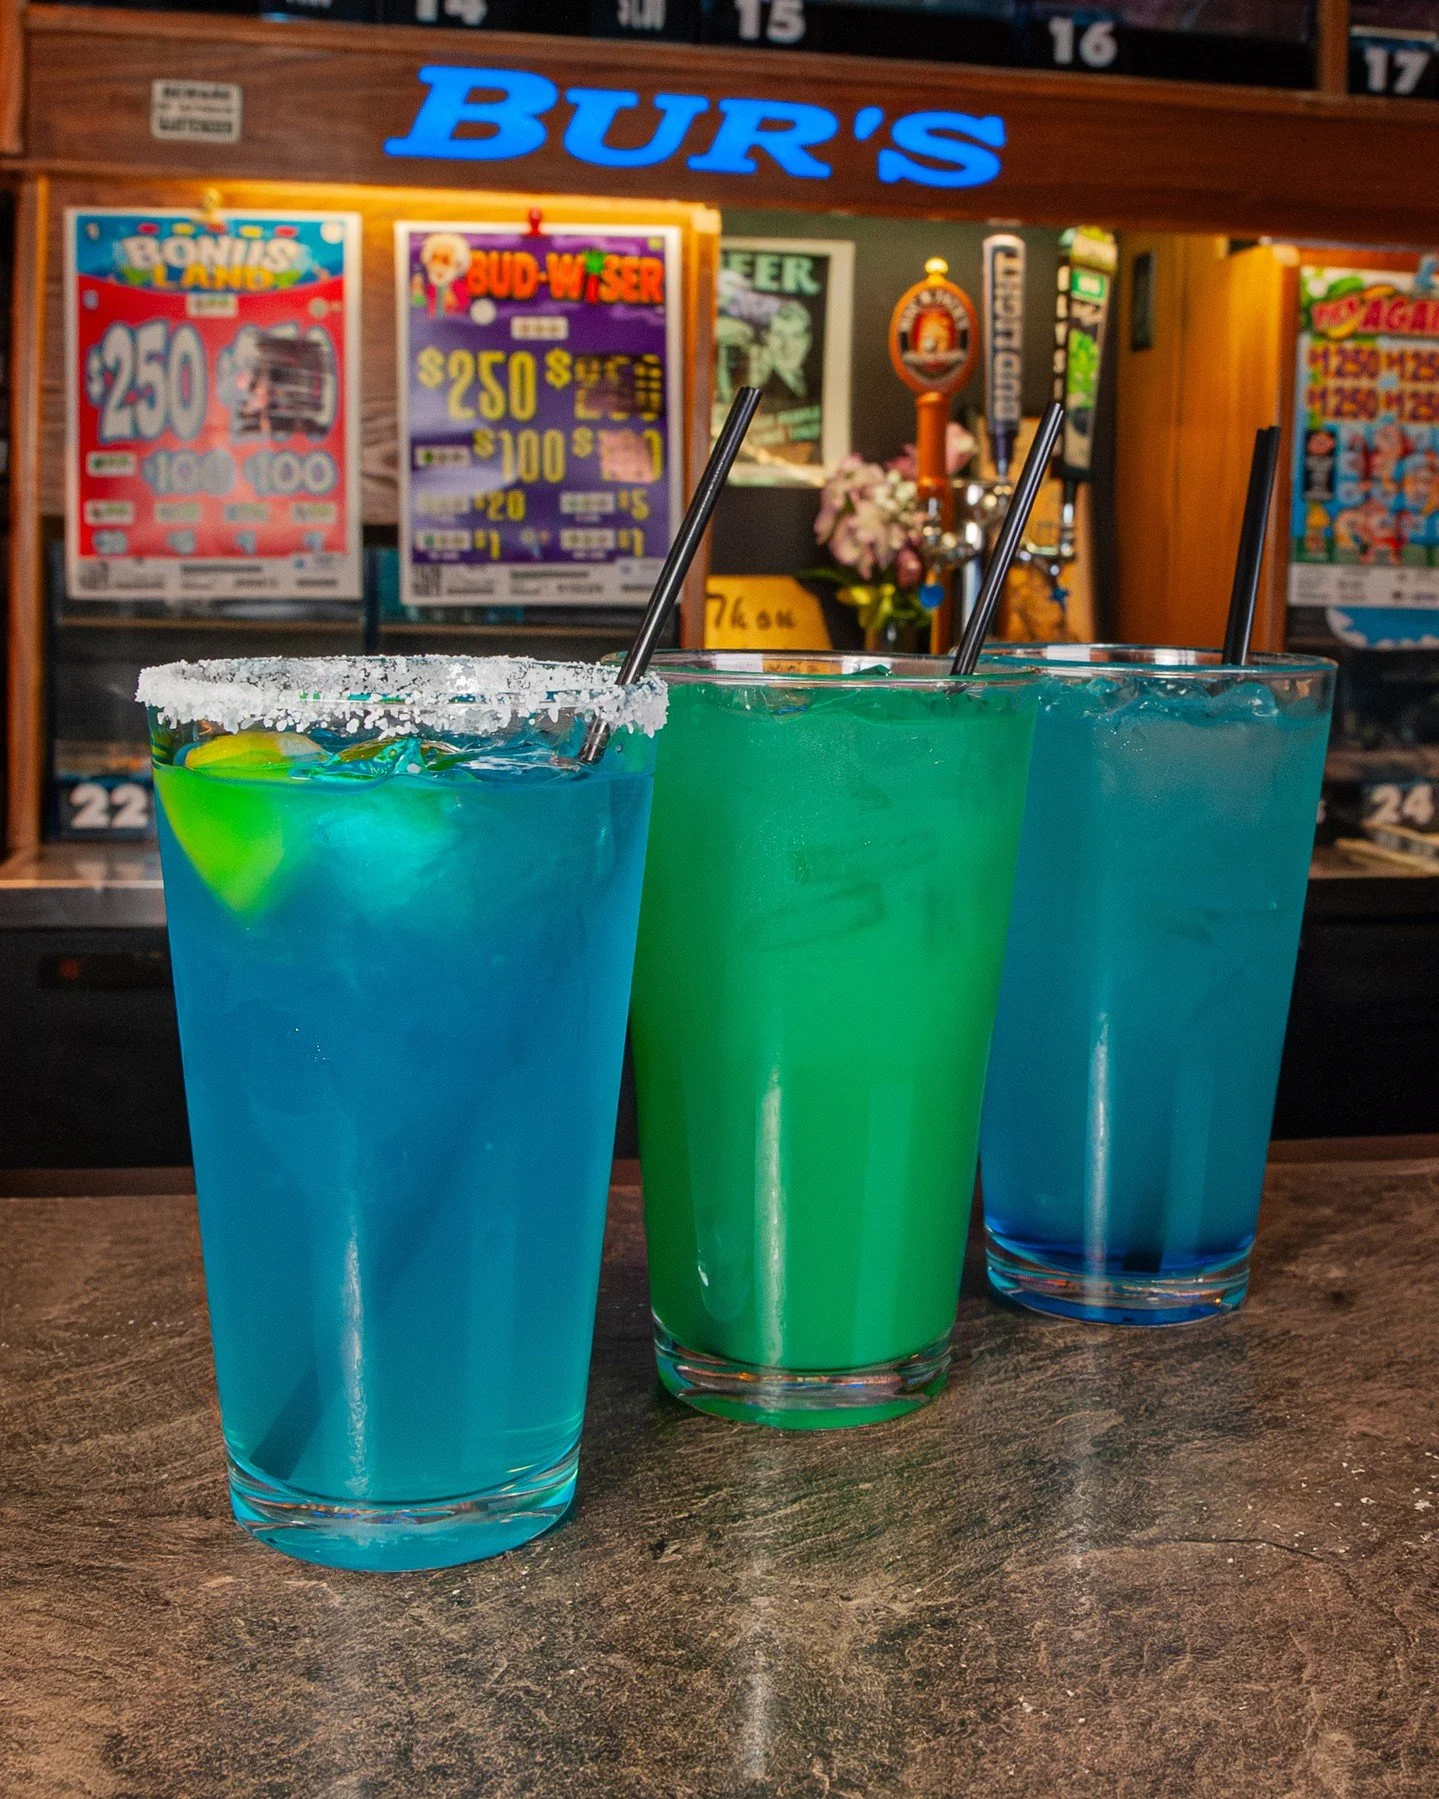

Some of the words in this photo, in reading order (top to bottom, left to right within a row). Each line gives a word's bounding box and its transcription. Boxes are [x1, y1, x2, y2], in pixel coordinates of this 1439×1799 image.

[737, 0, 806, 43] 15
[1049, 17, 1118, 67] 16
[1363, 47, 1428, 95] 17
[383, 65, 1006, 189] BUR'S
[123, 235, 302, 272] BONUS
[152, 262, 277, 292] LAND
[86, 320, 208, 444] $250
[417, 347, 538, 422] $250
[472, 426, 567, 484] $100
[70, 782, 149, 830] 22
[1362, 783, 1434, 825] 24
